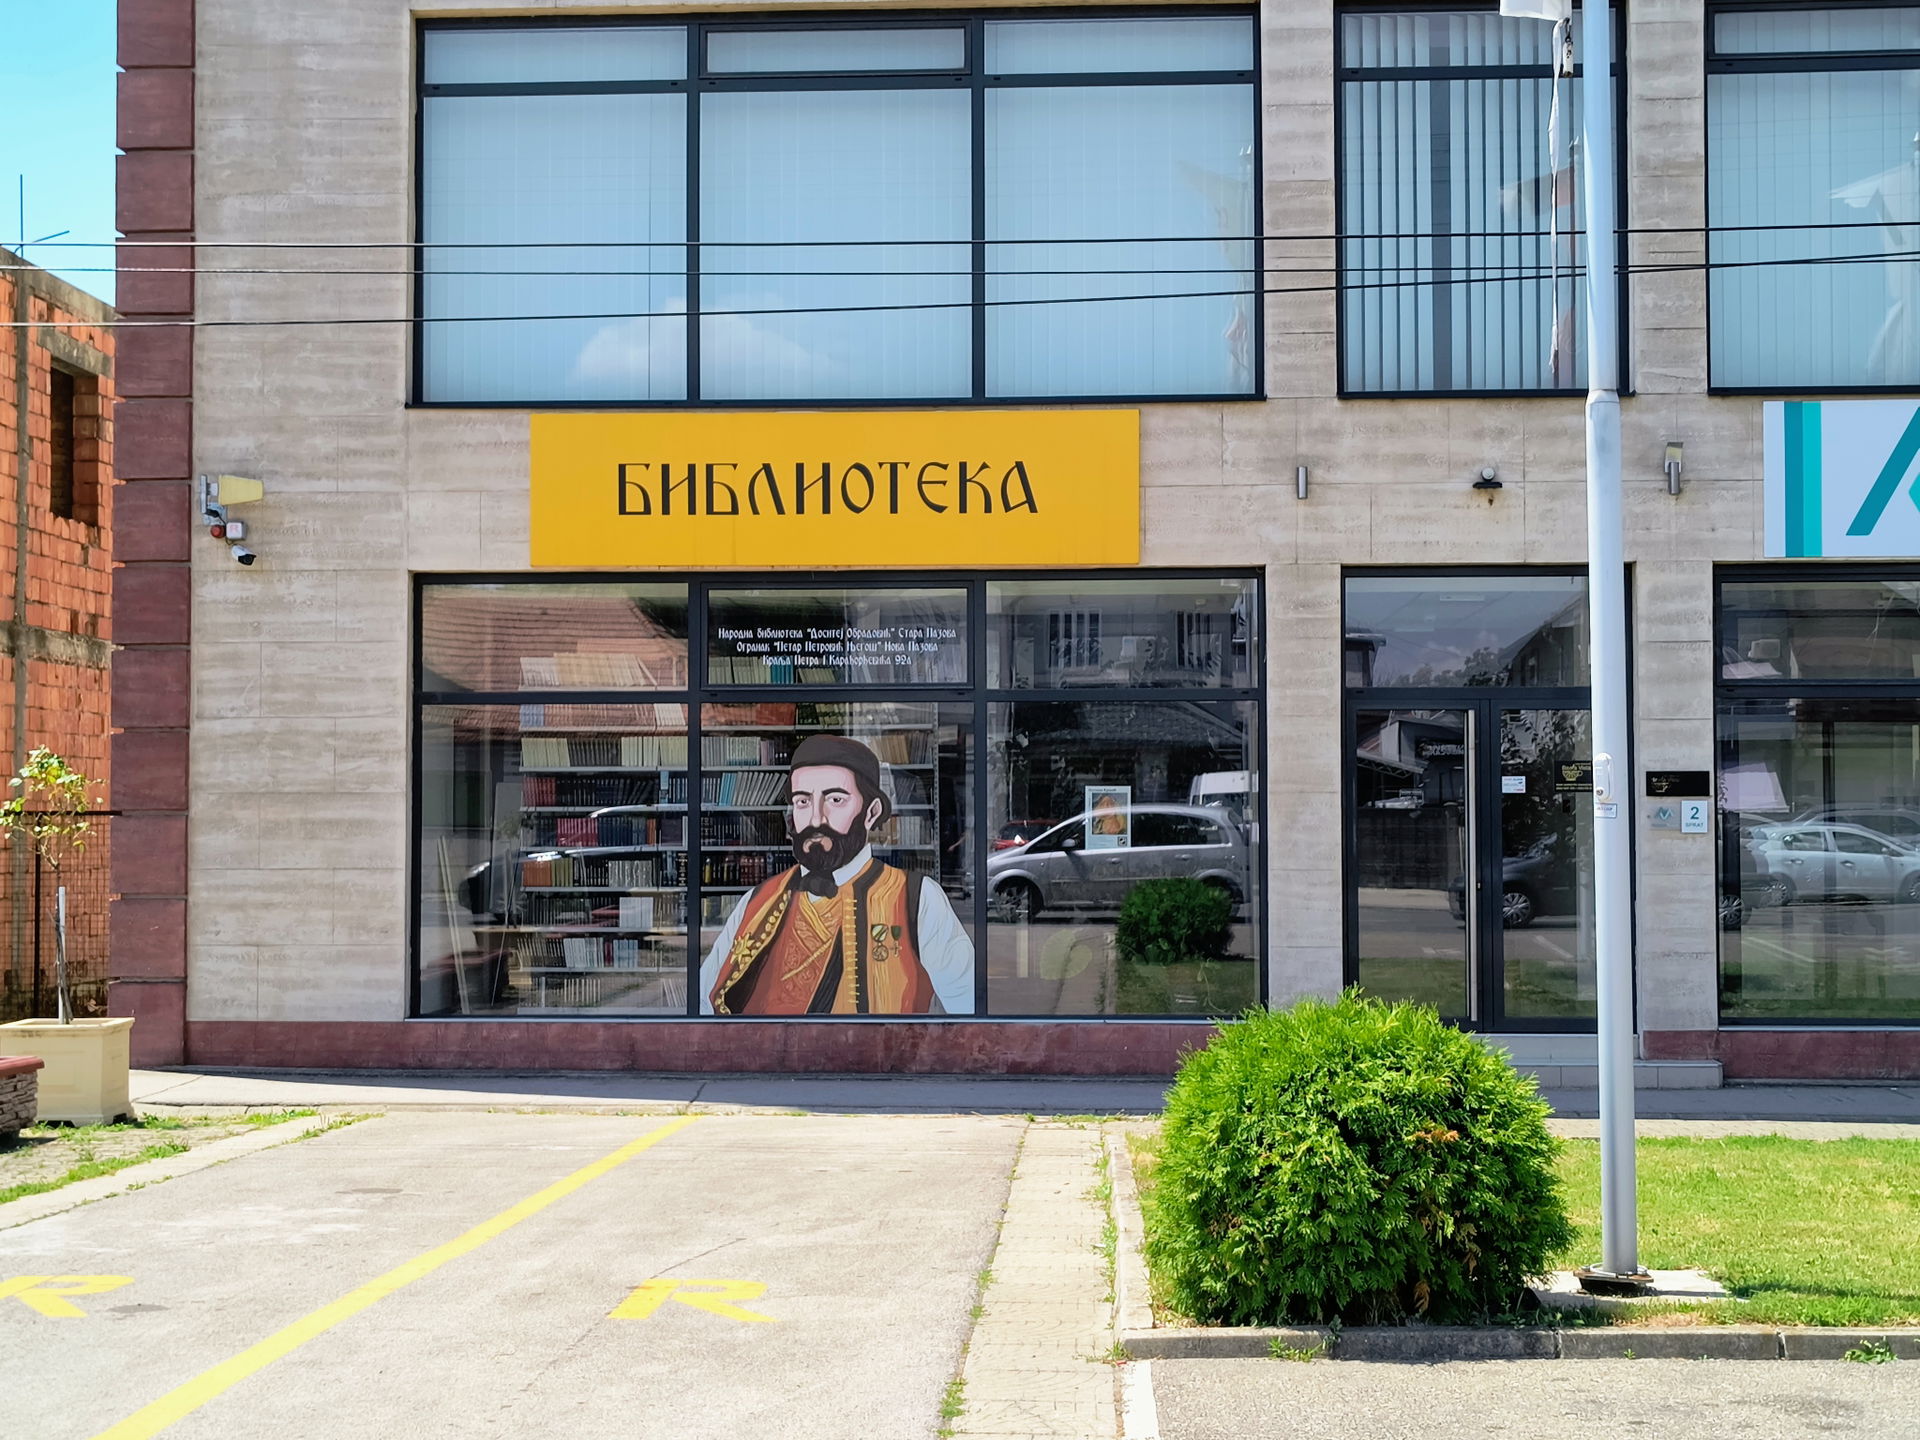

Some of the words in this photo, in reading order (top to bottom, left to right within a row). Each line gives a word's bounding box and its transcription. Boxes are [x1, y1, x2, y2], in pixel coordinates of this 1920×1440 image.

[617, 460, 1040, 516] БИБЛИОТЕКА
[718, 628, 754, 640] Народна
[898, 628, 924, 640] Стара
[926, 627, 957, 640] Пазова
[736, 641, 770, 654] Огранак
[884, 641, 905, 652] Нова
[908, 641, 939, 654] Пазова
[794, 655, 819, 667] Петра
[1690, 806, 1700, 820] 2
[607, 1279, 779, 1323] R
